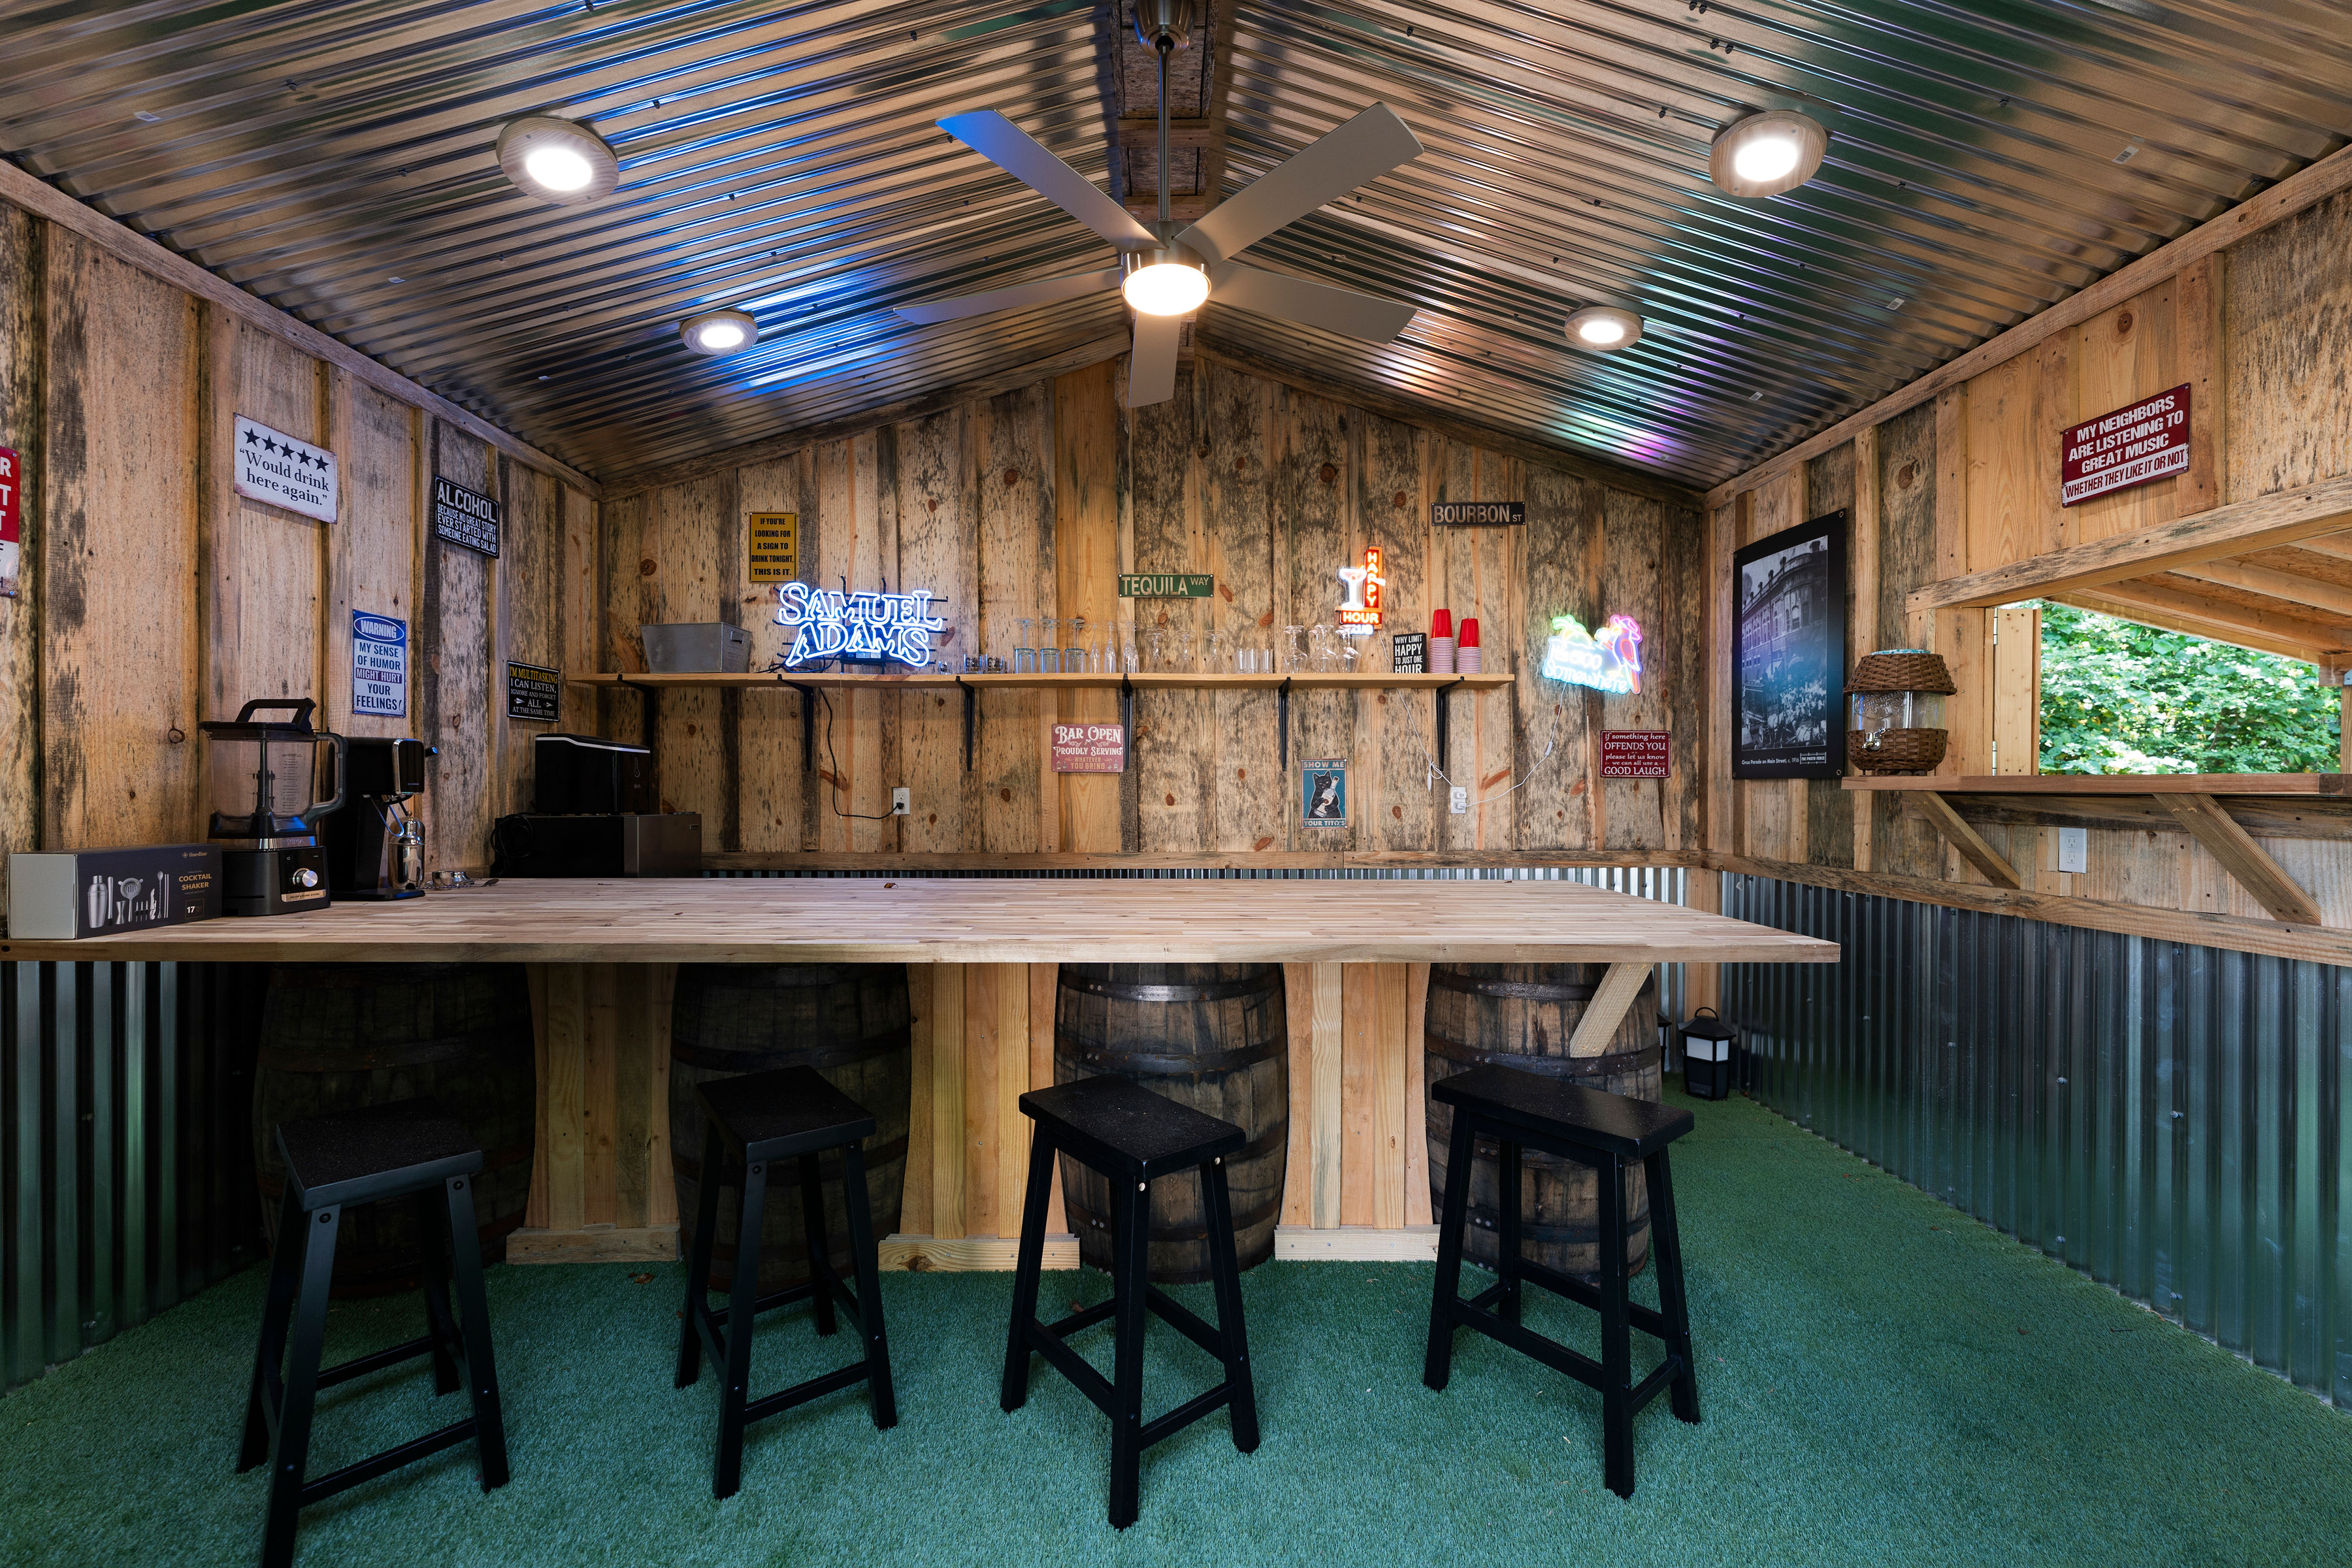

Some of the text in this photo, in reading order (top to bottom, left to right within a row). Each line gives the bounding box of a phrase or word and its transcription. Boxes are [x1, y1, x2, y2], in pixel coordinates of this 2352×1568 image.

[2077, 395, 2175, 443] MY NEIGHBORS
[2068, 410, 2183, 462] ARE LISTENING TO
[2082, 433, 2169, 473] GREAT MUSIC
[240, 448, 329, 491] “Would drink
[2065, 449, 2185, 498] WHETHER THEY LIKE IT OR NOT
[246, 467, 327, 506] here again.”
[437, 482, 497, 523] ALCOHOL
[437, 502, 497, 534] BECAUSE NO GREAT STORY
[1434, 505, 1510, 523] BOURBON
[438, 514, 497, 544] EVER STARTED WITH
[438, 524, 497, 553] SOMEONE EATING SALAD
[769, 555, 794, 563] TONIGHT,
[1121, 576, 1209, 596] TEQUILA WAY
[1366, 551, 1379, 606] HAPPY
[778, 581, 943, 632] SAMUEL
[1343, 612, 1379, 623] HOUR
[360, 619, 397, 639] WARNING
[785, 621, 930, 667] ADAMS
[1395, 634, 1422, 644] WHY LIMIT
[359, 642, 399, 658] MY SENSE
[1395, 643, 1422, 657] HAPPY
[357, 655, 400, 671] OF HUMOR
[1395, 663, 1422, 674] HOUR
[1401, 656, 1413, 664] JUST
[356, 668, 401, 683] MIGHT HURT
[509, 666, 558, 684] I'M MULTITASKING
[367, 683, 391, 696] YOUR
[510, 678, 557, 694] I CAN LISTEN,
[356, 694, 402, 711] FEELINGS!
[527, 698, 541, 708] ALL
[1605, 732, 1612, 741] if
[1612, 733, 1648, 742] something
[1646, 742, 1666, 751] YOU
[1604, 766, 1631, 775] GOOD
[178, 873, 212, 883] COCKTAIL
[182, 882, 209, 890] SHAKER
